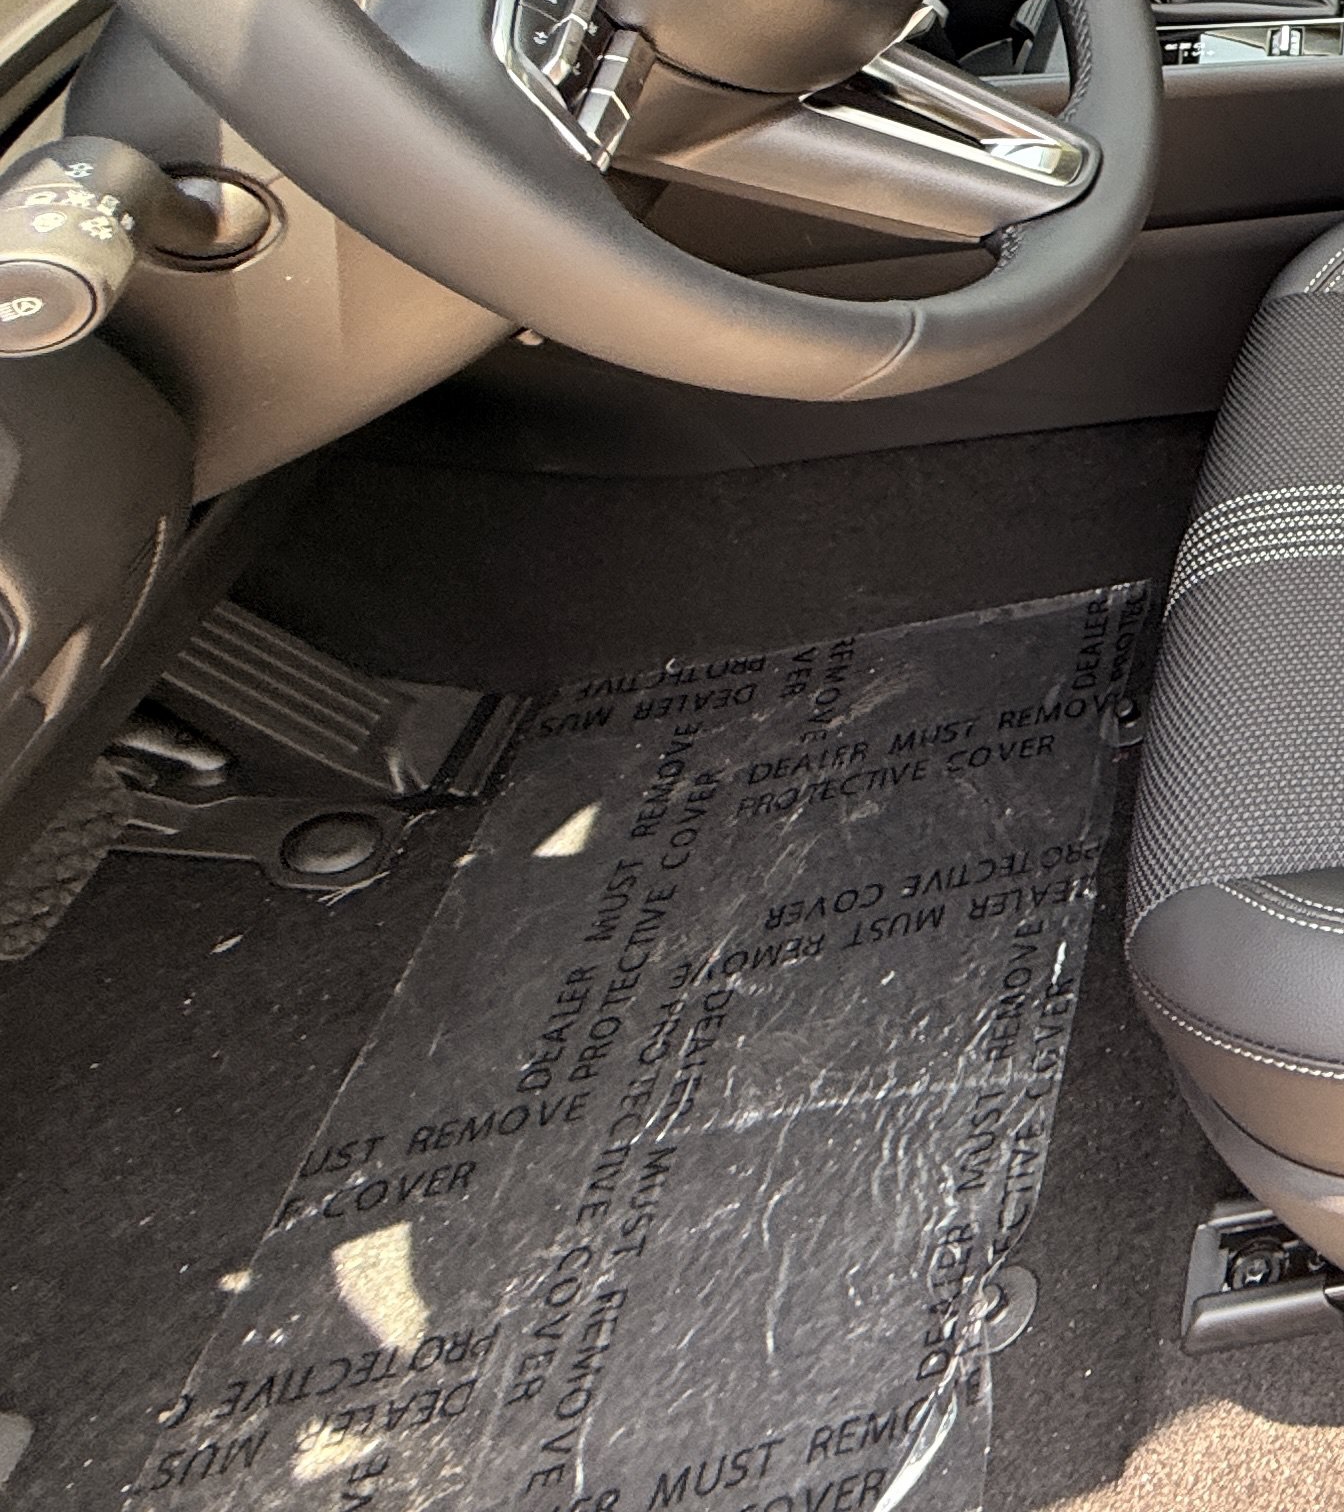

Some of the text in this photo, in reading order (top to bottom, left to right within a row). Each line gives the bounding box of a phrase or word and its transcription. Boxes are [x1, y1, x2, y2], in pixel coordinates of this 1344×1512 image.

[1072, 598, 1109, 690] DEALER
[633, 683, 758, 721] DEALER
[747, 691, 1121, 785] DEALER MUST REMOV
[735, 734, 1056, 817] PROTECTIVE COVER
[517, 721, 701, 1093] DEALER MUST REMOVE
[568, 770, 721, 1085] PROTECTIVE COVER
[765, 844, 1100, 930] PROTECTIVE COVER
[842, 903, 946, 950] MUST
[406, 1091, 592, 1156] REMOVE
[577, 999, 684, 1226] PROTECTIVE
[958, 1091, 1004, 1194] MUST
[322, 1160, 477, 1219] COVER
[613, 1146, 678, 1257] MUST
[215, 1322, 502, 1420] PROTECTIVE
[504, 1246, 592, 1408] COVER
[526, 1287, 629, 1495] REMOVE
[648, 1438, 785, 1511] MUST
[740, 1470, 887, 1512] OVER
